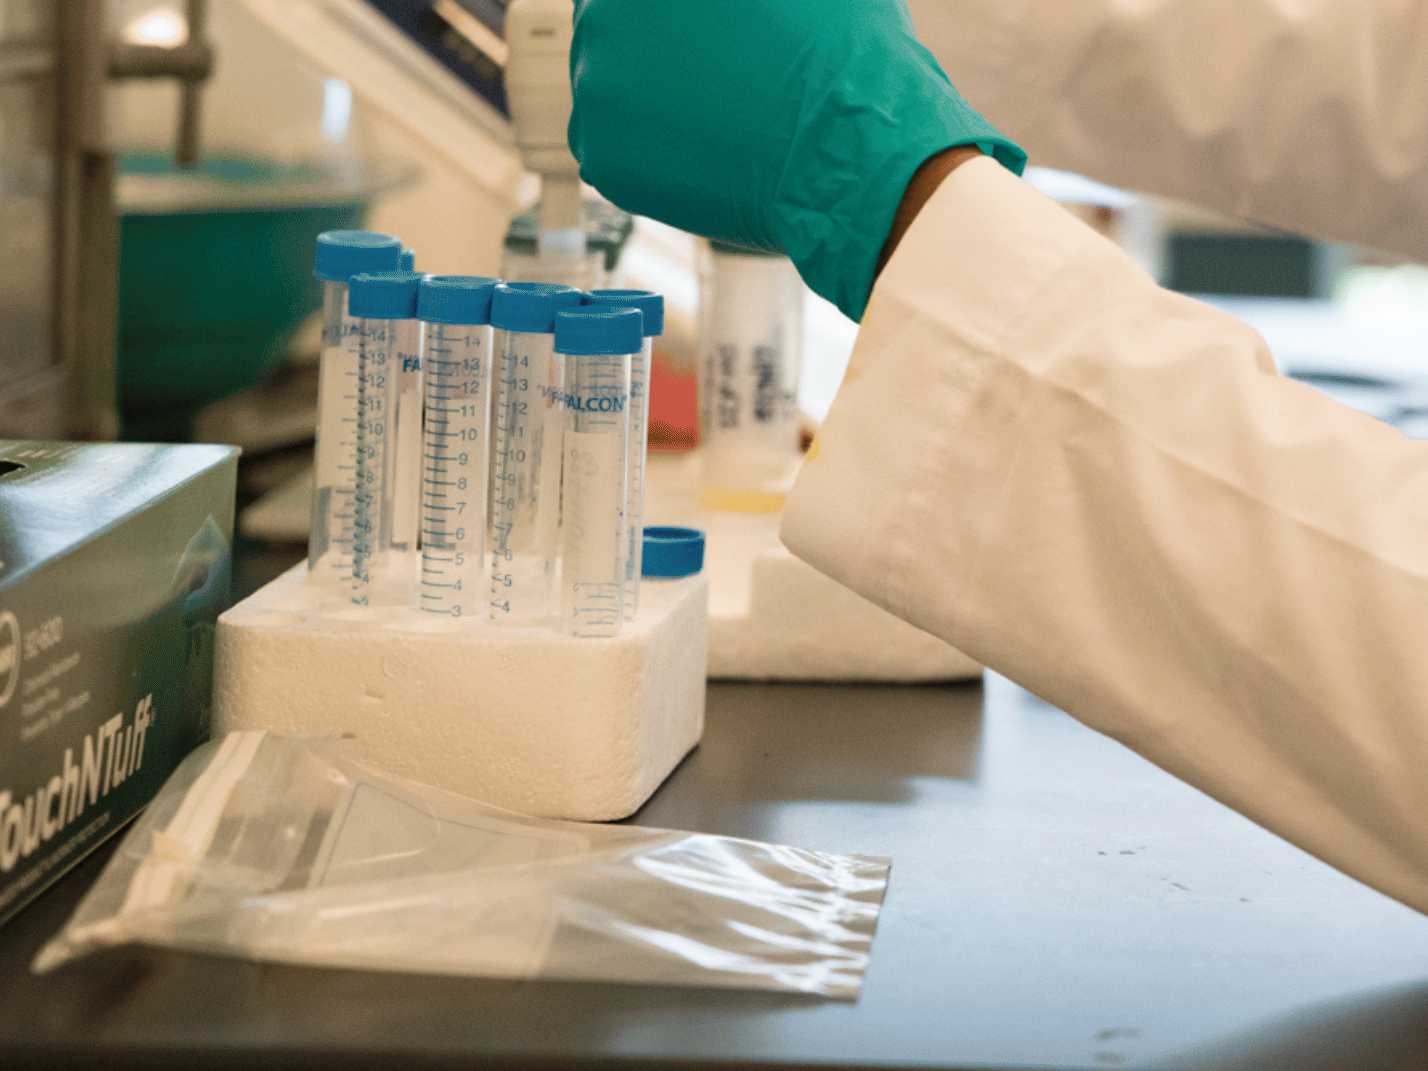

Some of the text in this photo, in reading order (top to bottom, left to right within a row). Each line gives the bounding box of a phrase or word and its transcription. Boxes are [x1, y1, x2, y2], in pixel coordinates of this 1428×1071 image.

[371, 353, 386, 365] 13
[463, 358, 480, 370] 13
[513, 354, 529, 368] 14
[370, 376, 385, 388] 12
[462, 381, 479, 394] 12
[512, 378, 528, 391] 13
[370, 400, 381, 411] 11
[461, 405, 475, 417] 11
[512, 402, 528, 415] 12
[369, 424, 383, 435] 10
[460, 429, 478, 441] 10
[510, 425, 523, 437] 11
[509, 450, 526, 463] 10
